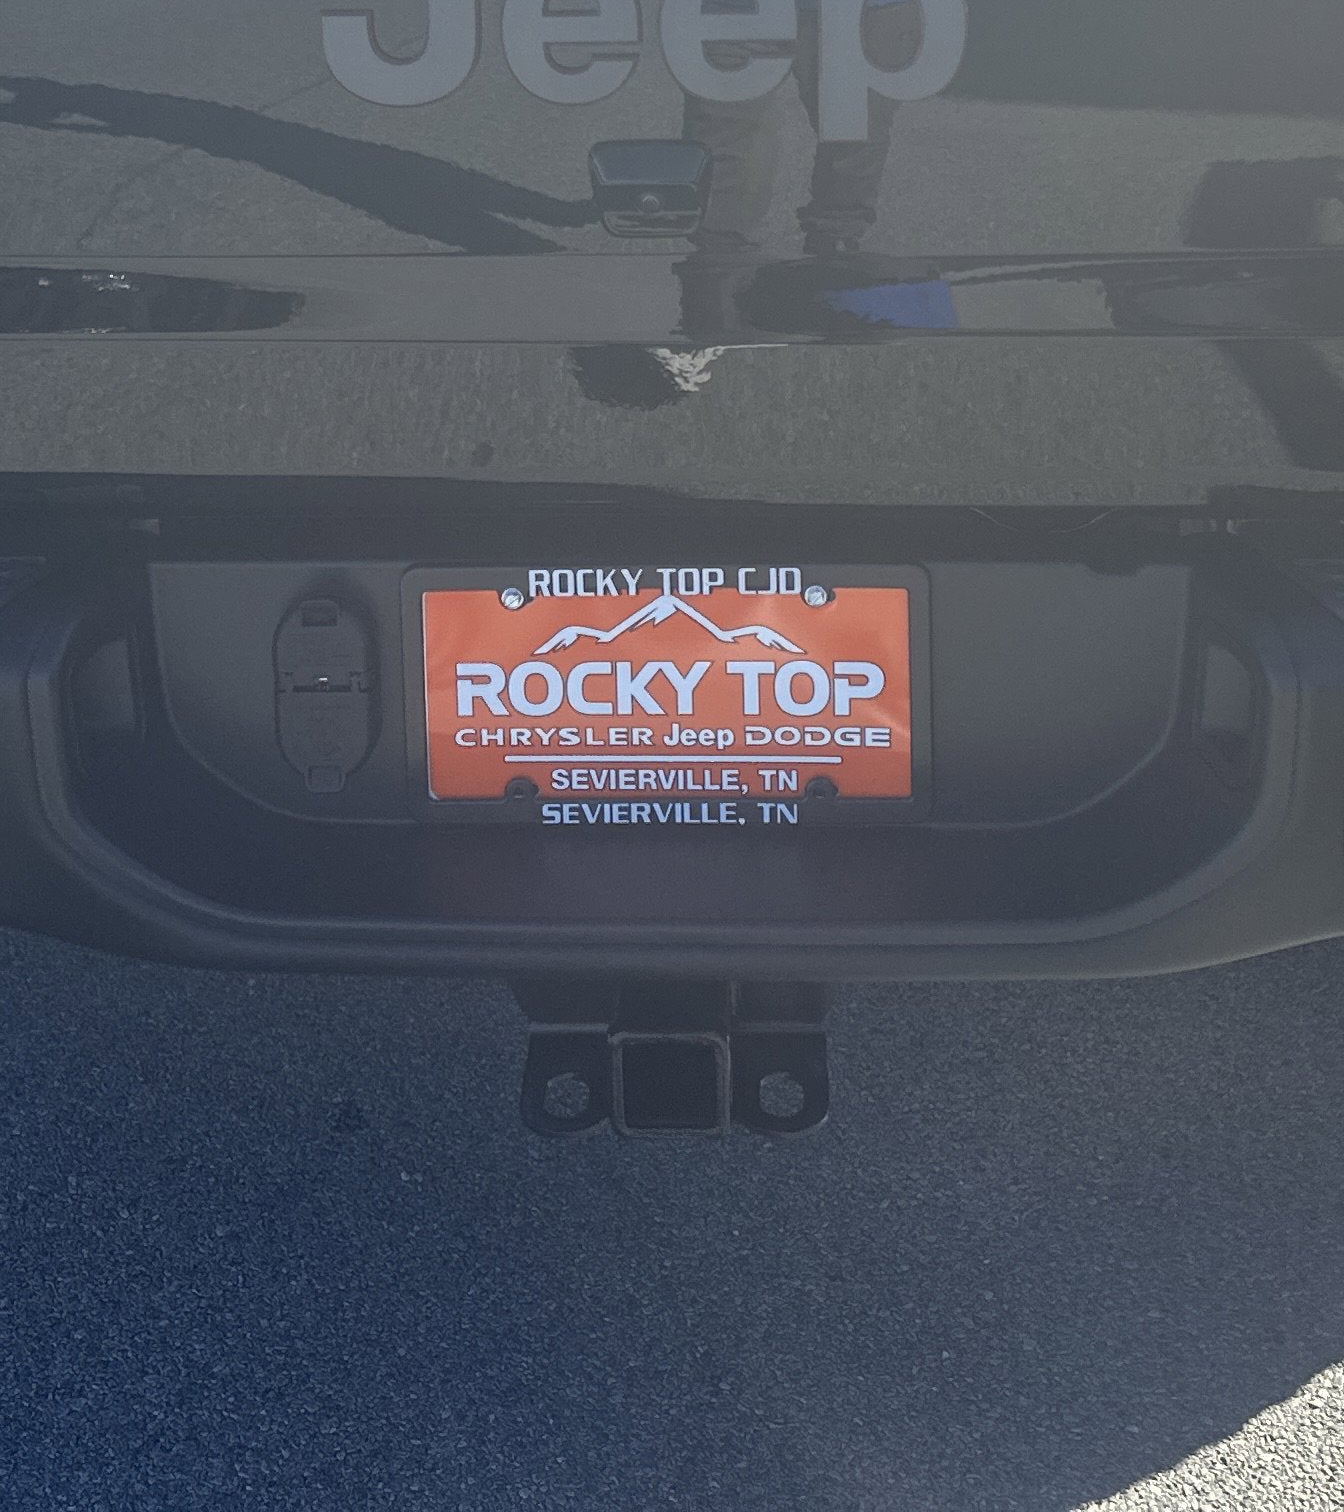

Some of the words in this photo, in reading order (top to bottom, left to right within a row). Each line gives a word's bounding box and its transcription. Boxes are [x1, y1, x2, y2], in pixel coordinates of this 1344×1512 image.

[528, 568, 643, 597] ROCKY
[657, 567, 725, 596] TOP
[738, 567, 802, 595] CJD
[455, 660, 712, 716] ROCKY
[726, 660, 886, 716] TOP
[454, 727, 654, 747] CHRYSLER
[662, 723, 735, 749] Jeep
[744, 726, 891, 747] DODGE
[551, 769, 749, 794] SEVIERVILLE,
[758, 769, 798, 791] TN
[542, 802, 747, 826] SEVIERVILLE,
[757, 801, 798, 824] TN
